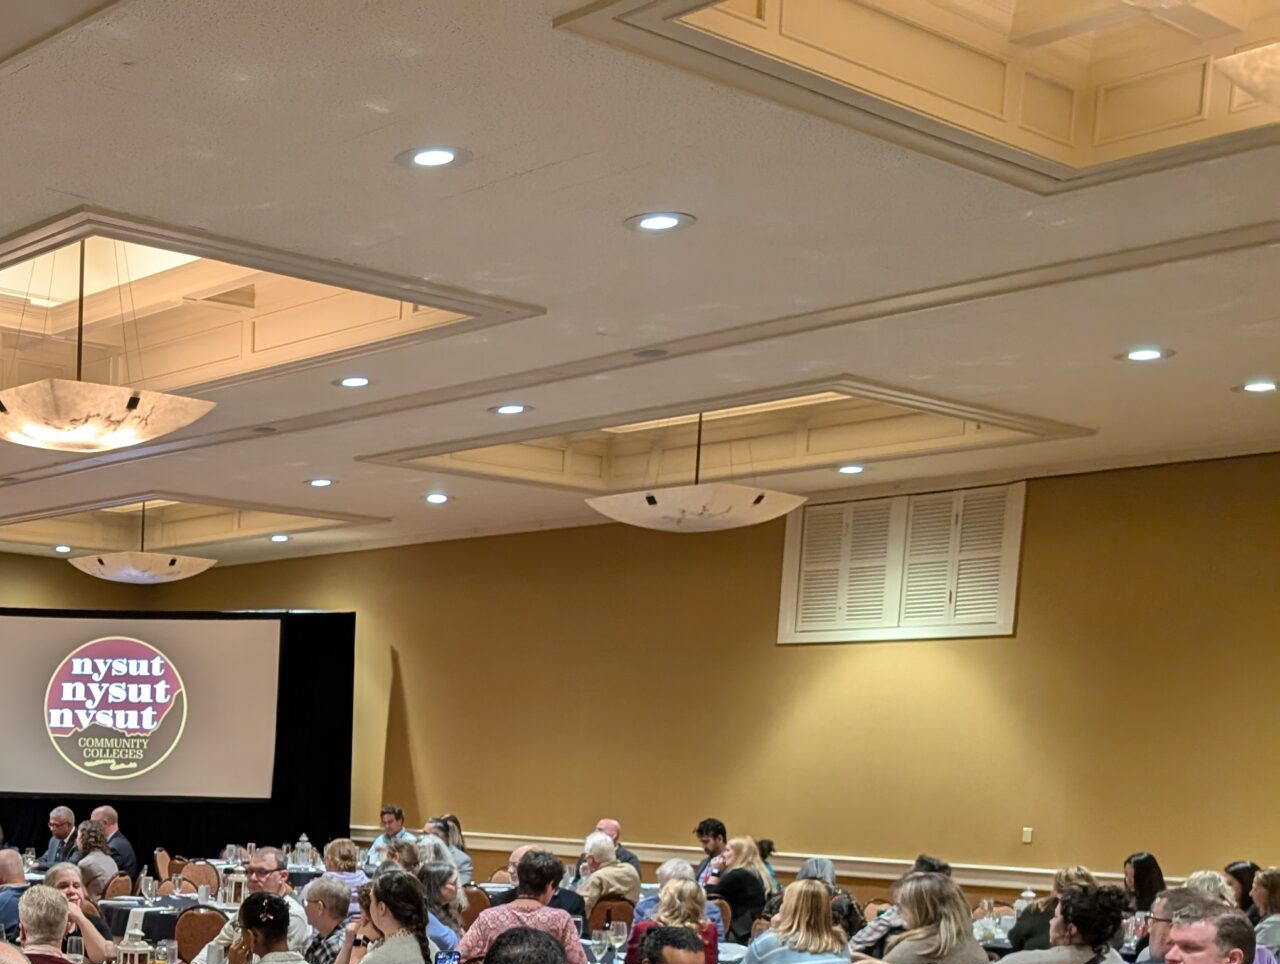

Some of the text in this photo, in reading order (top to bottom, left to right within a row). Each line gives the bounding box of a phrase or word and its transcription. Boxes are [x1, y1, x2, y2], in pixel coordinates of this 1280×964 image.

[72, 656, 165, 681] nysut
[61, 680, 171, 709] nysut
[49, 706, 158, 730] nysut
[78, 737, 149, 749] COMMUNITY
[83, 748, 143, 759] COLLEGES
